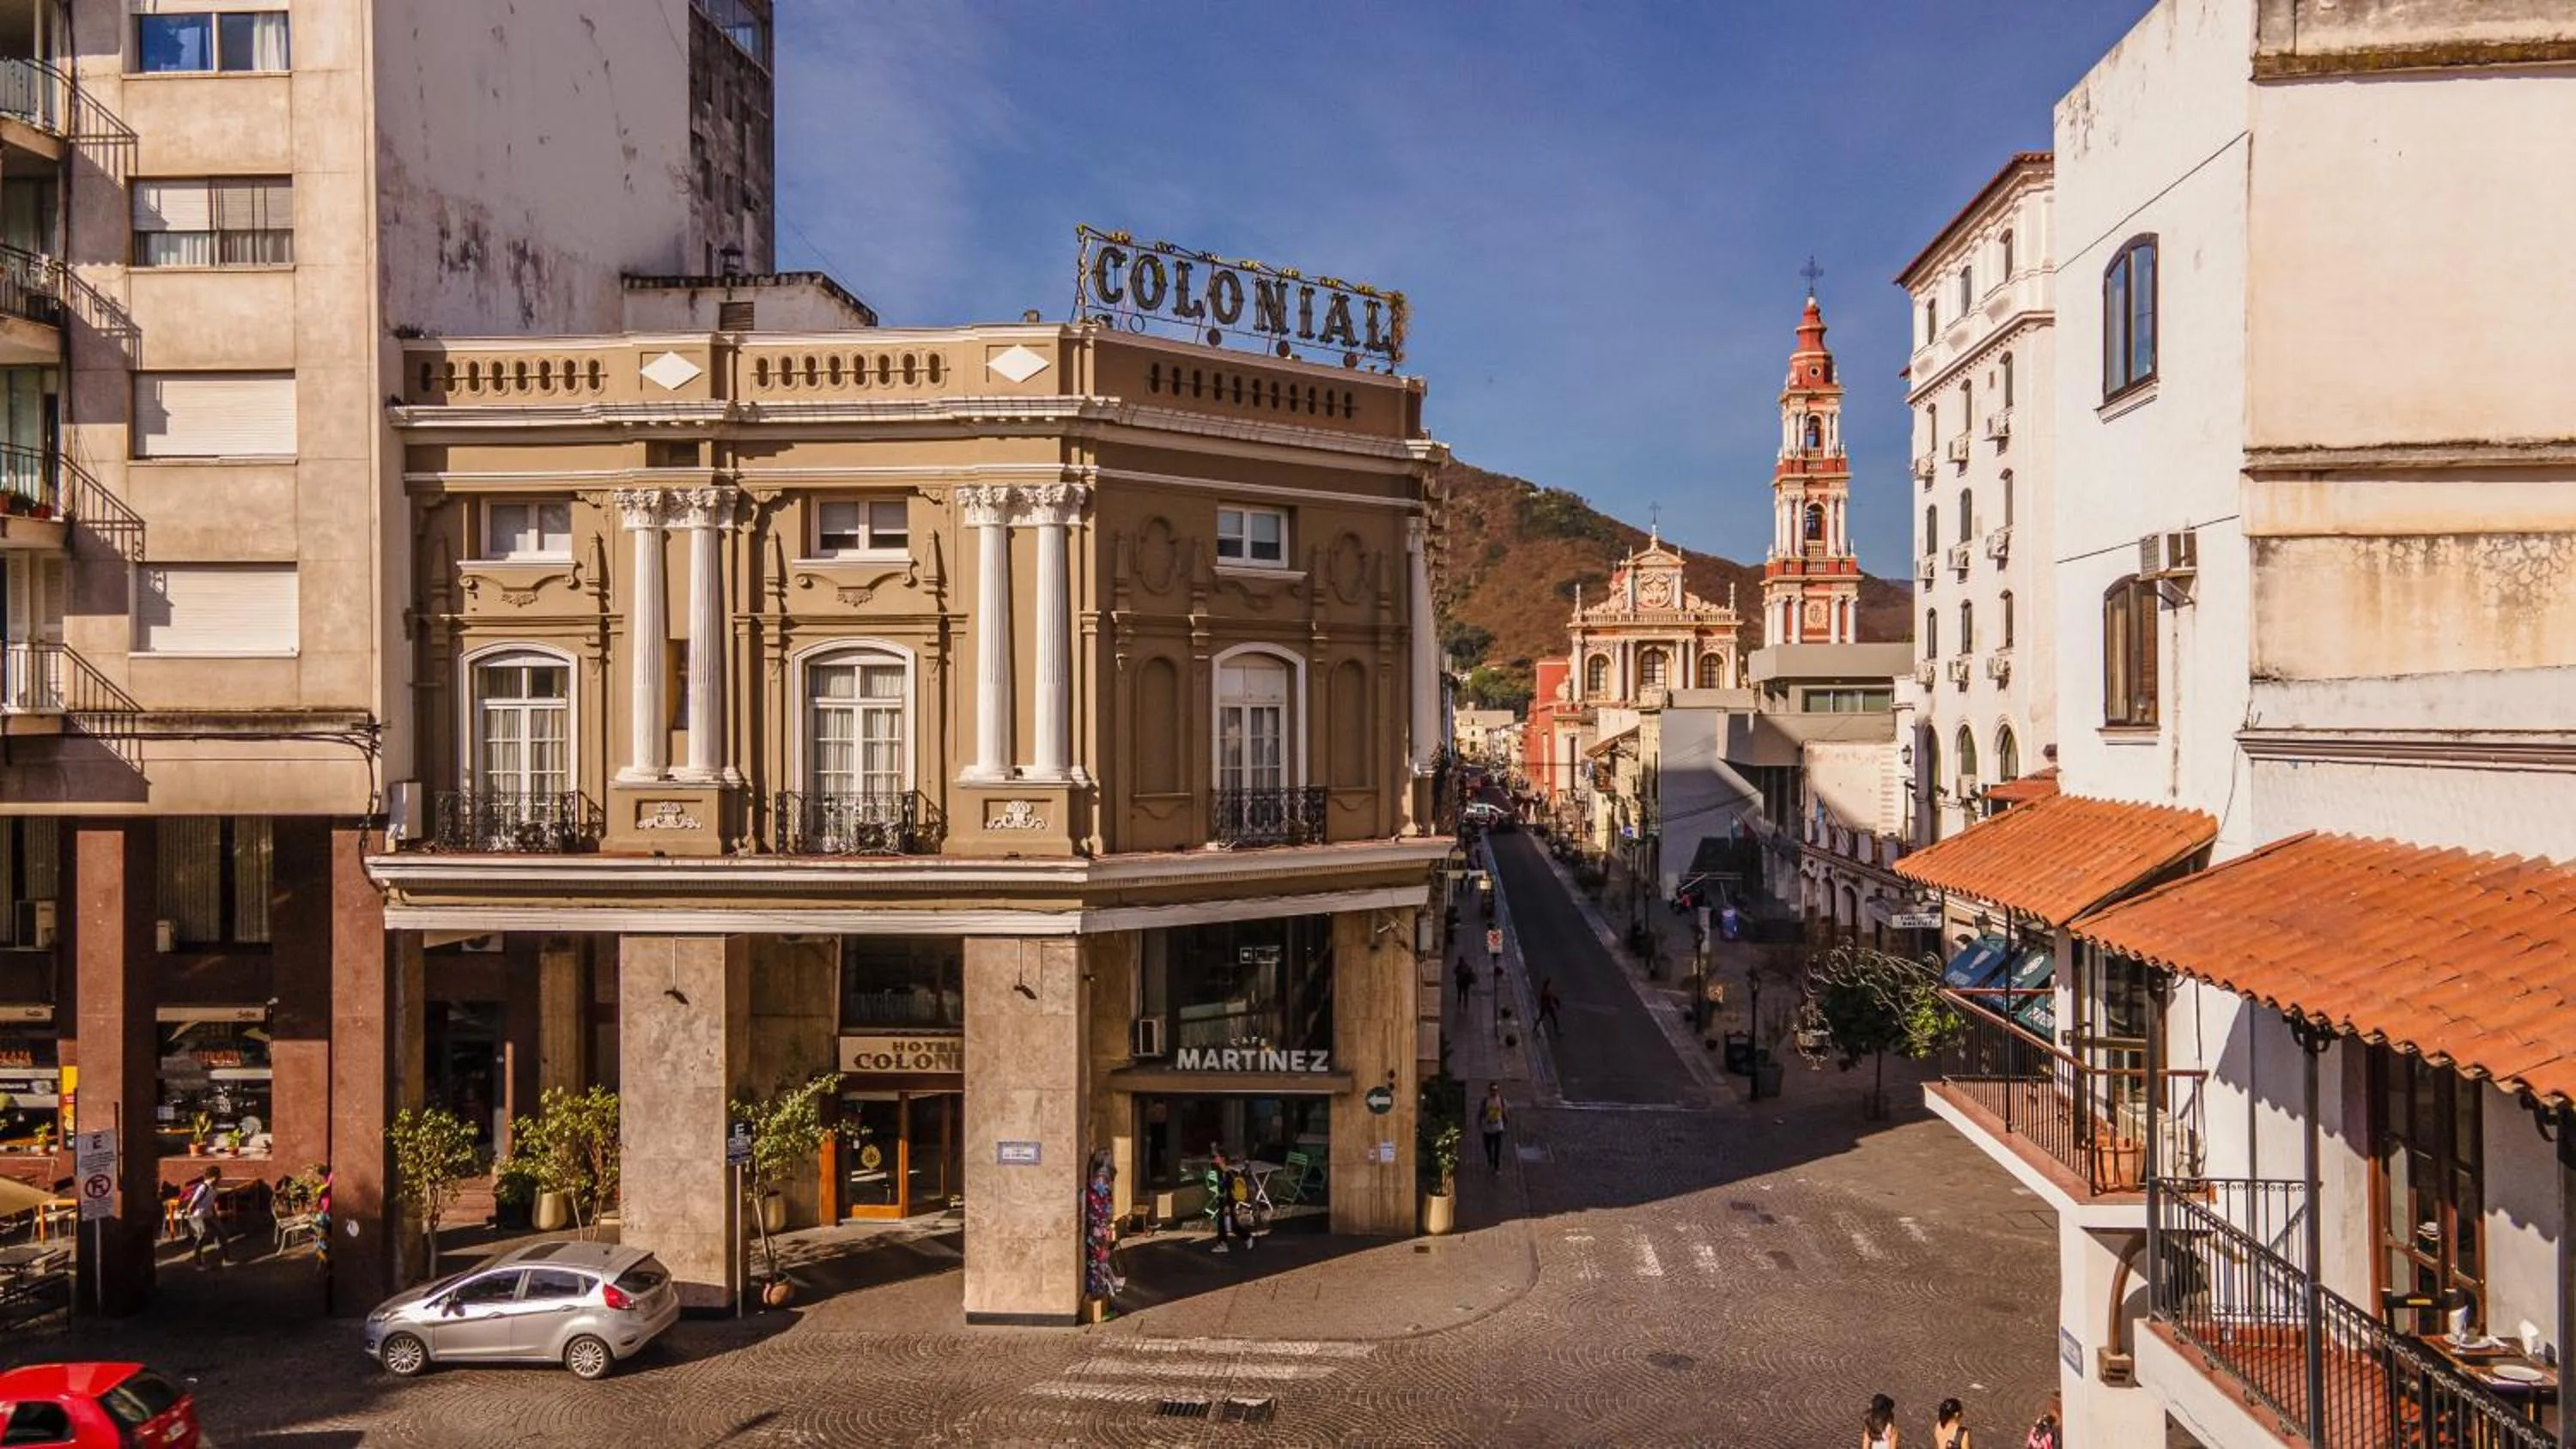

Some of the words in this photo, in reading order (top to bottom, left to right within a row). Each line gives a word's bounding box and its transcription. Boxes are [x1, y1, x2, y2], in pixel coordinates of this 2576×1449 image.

[1093, 246, 1393, 352] COLONIAL
[892, 1041, 962, 1052] HOTEL
[1176, 1047, 1329, 1072] MARTINEZ
